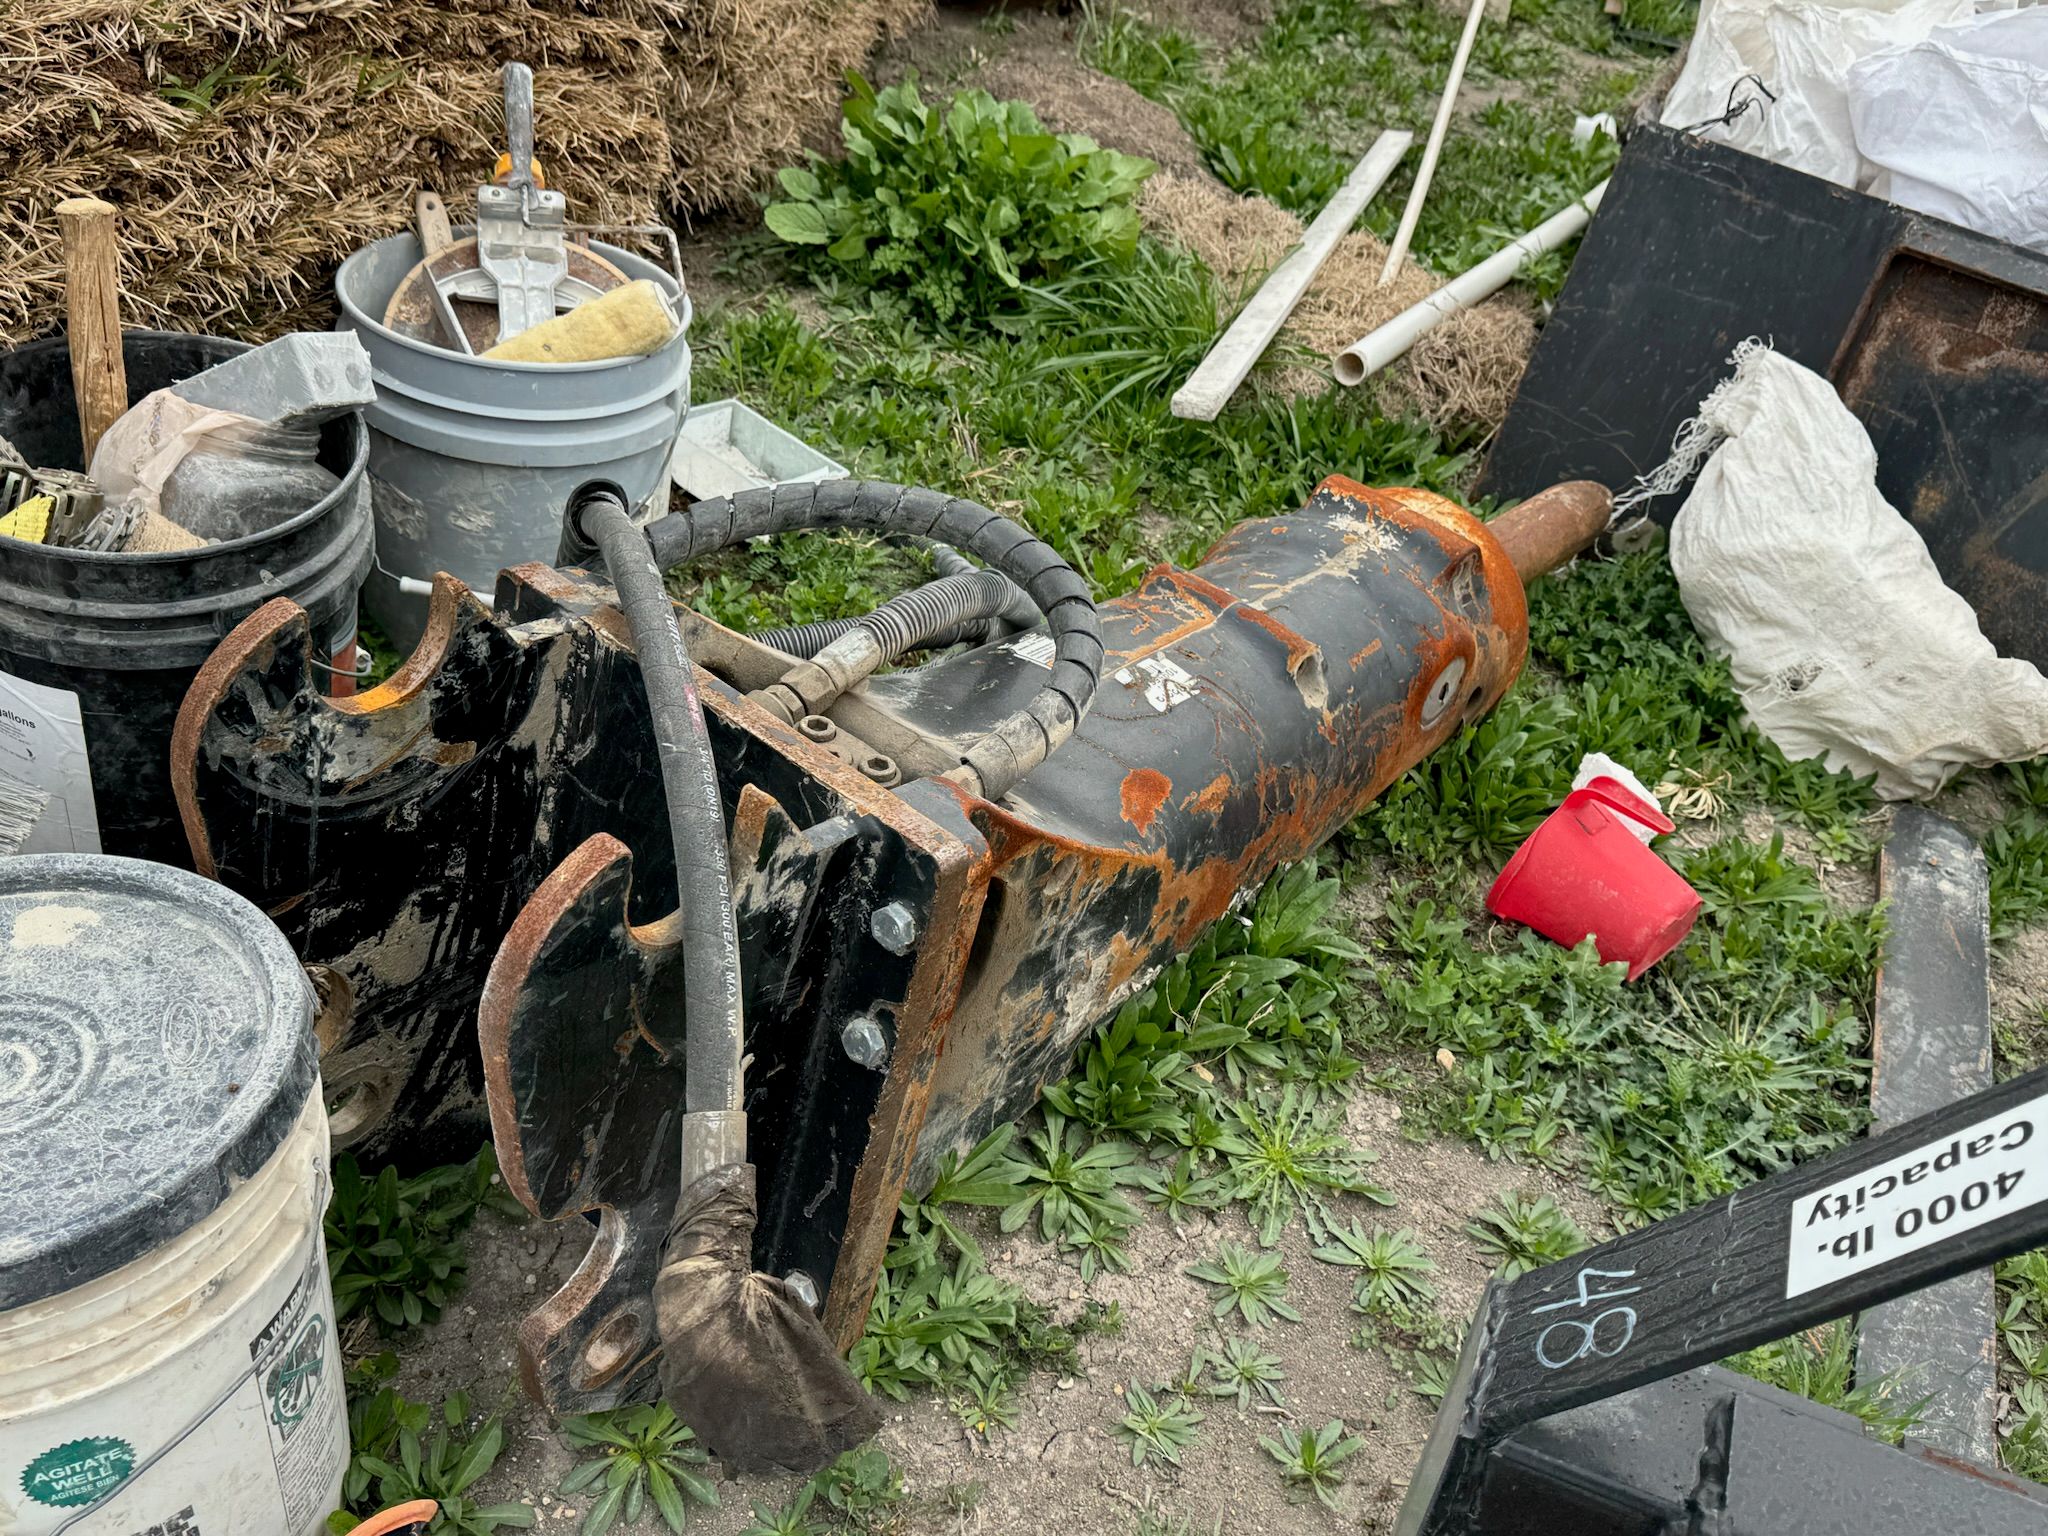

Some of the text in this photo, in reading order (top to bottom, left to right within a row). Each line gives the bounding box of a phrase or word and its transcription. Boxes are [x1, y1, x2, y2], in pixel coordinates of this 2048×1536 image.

[726, 972, 737, 1004] MAX
[727, 1010, 738, 1039] W.P.
[1806, 1121, 2034, 1227] Capacity
[1817, 1169, 2025, 1259] 4000 lb.
[34, 1448, 122, 1484] AGITATE
[51, 1465, 112, 1491] WELL
[51, 1474, 120, 1501] AGITESE BIEN
